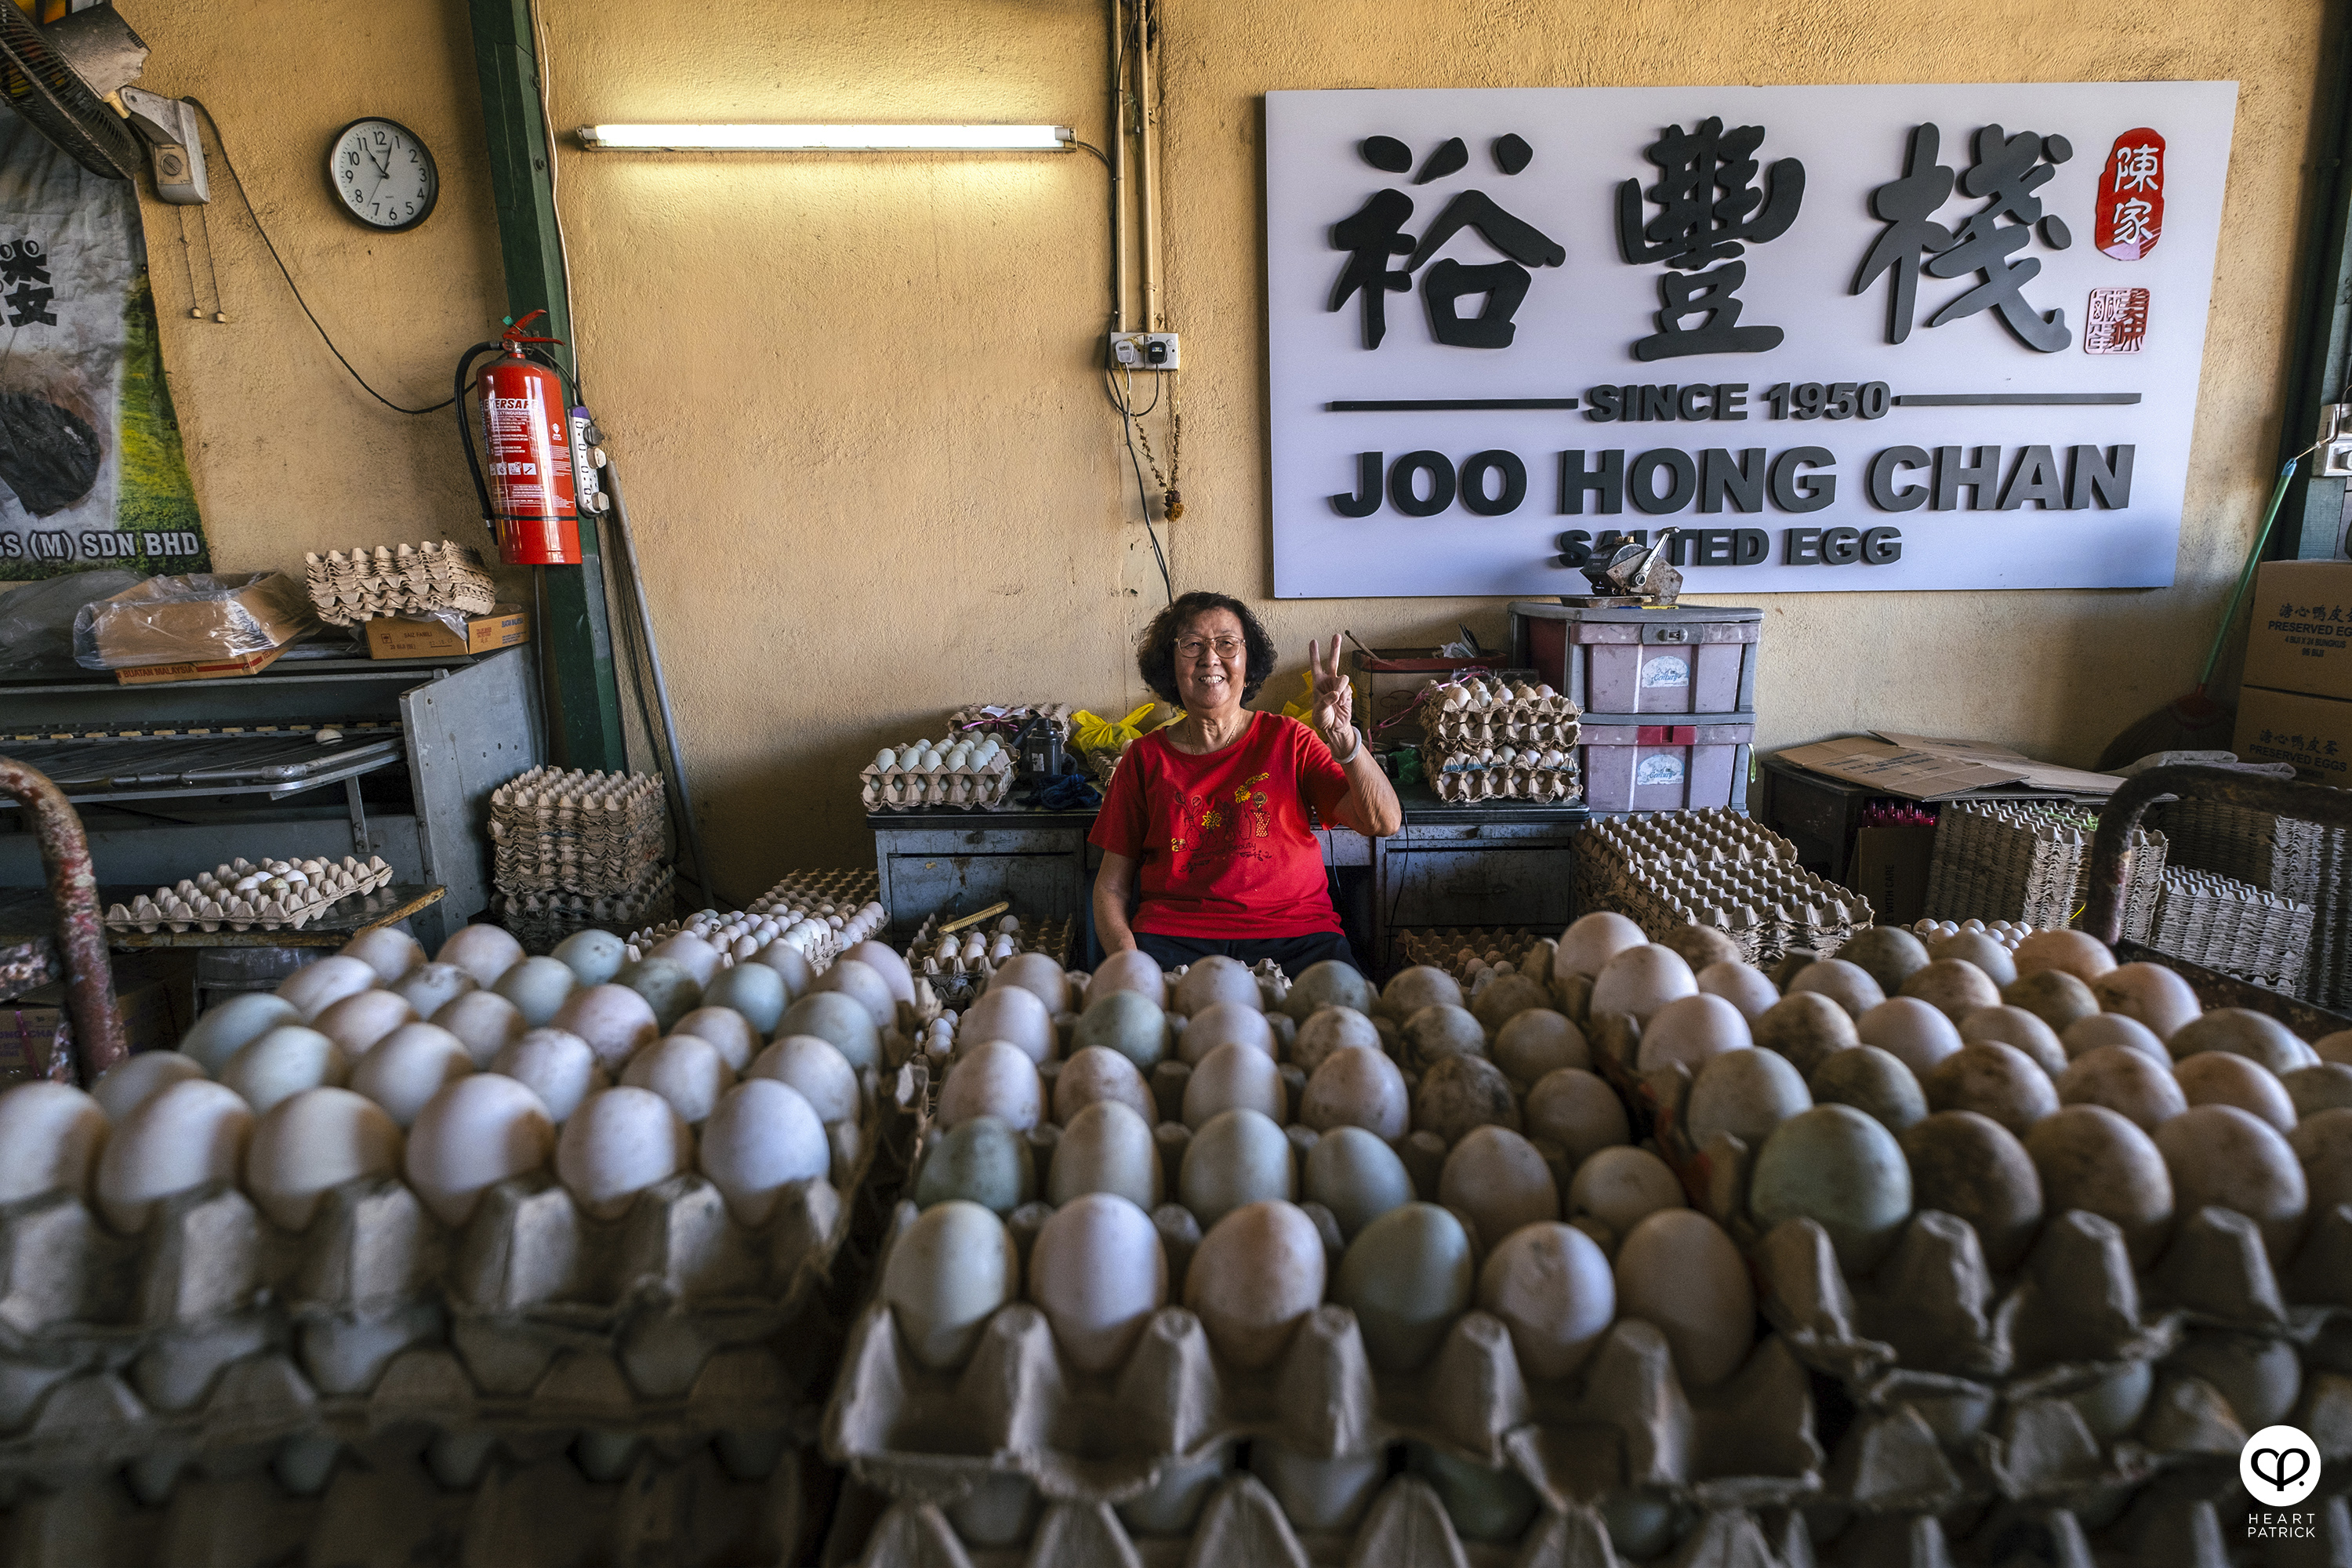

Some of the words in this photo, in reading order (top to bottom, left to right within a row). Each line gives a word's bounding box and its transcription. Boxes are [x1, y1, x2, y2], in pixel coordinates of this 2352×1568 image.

[358, 137, 368, 151] 11
[373, 131, 387, 145] 12
[395, 136, 400, 149] 1
[348, 151, 360, 165] 10
[408, 149, 418, 162] 2
[346, 170, 353, 183] 9
[419, 168, 427, 182] 3
[355, 189, 363, 203] 8
[417, 187, 424, 200] 4
[2113, 143, 2158, 245] 陳家
[372, 203, 379, 216] 7
[389, 207, 397, 220] 6
[405, 201, 414, 215] 5
[1584, 383, 1748, 422] SINCE
[1765, 381, 1891, 421] 1950
[1332, 450, 1527, 518] JOO
[1563, 446, 1837, 515] HONG
[1870, 444, 2134, 511] CHAN
[0, 533, 22, 557] S
[31, 532, 74, 561] (M)
[82, 533, 136, 557] SDN
[143, 532, 199, 556] BHD
[1788, 526, 1902, 564] EGG
[2268, 621, 2333, 635] PRESERVED
[2314, 638, 2347, 648] BUNGKUS
[123, 668, 154, 678] BUATAN
[155, 666, 194, 676] MALAYSIA
[2249, 744, 2311, 764] PRESERVED
[2314, 757, 2347, 772] EGGS
[1228, 841, 1256, 851] Beauty
[1885, 864, 1894, 887] CARE
